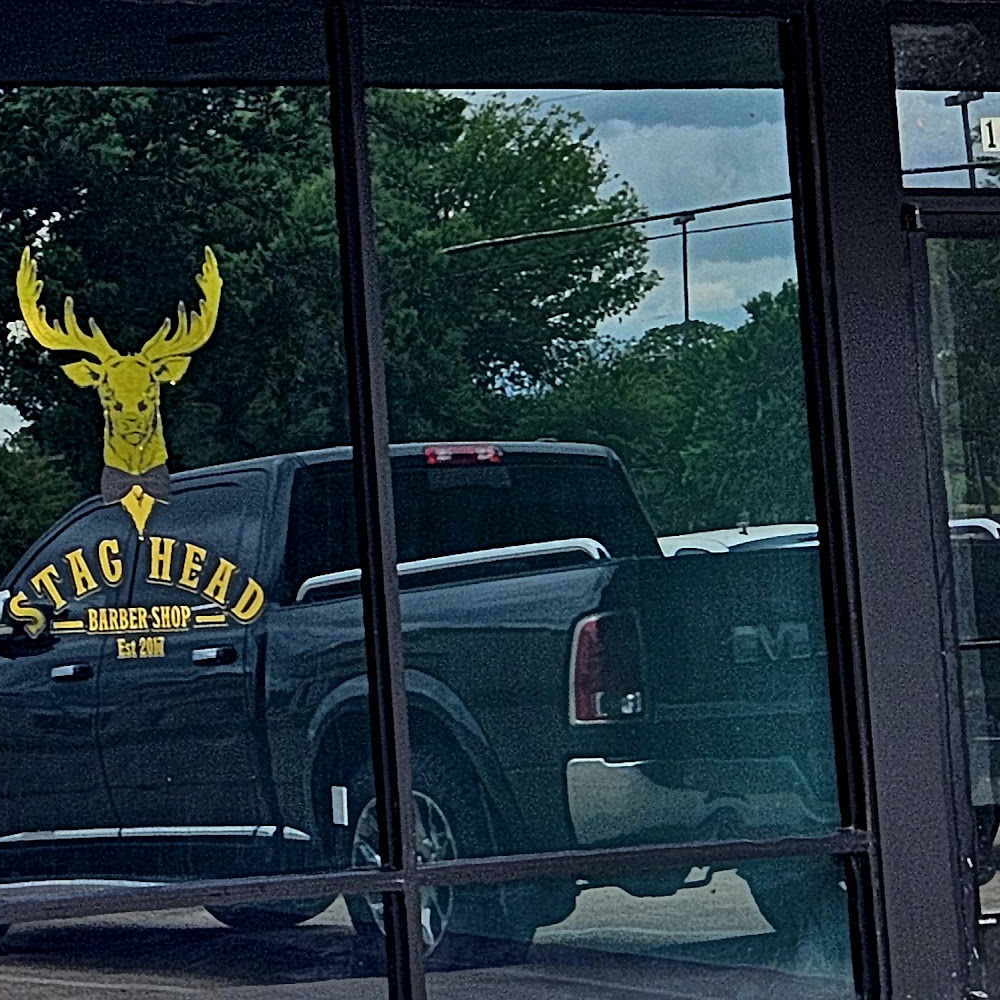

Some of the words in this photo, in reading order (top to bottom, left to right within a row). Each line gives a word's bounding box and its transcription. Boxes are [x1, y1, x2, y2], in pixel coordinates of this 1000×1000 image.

[8, 538, 124, 639] STAG
[147, 536, 266, 625] HEAD
[87, 606, 149, 632] BARBER
[151, 604, 192, 629] SHOP
[117, 637, 138, 658] Est
